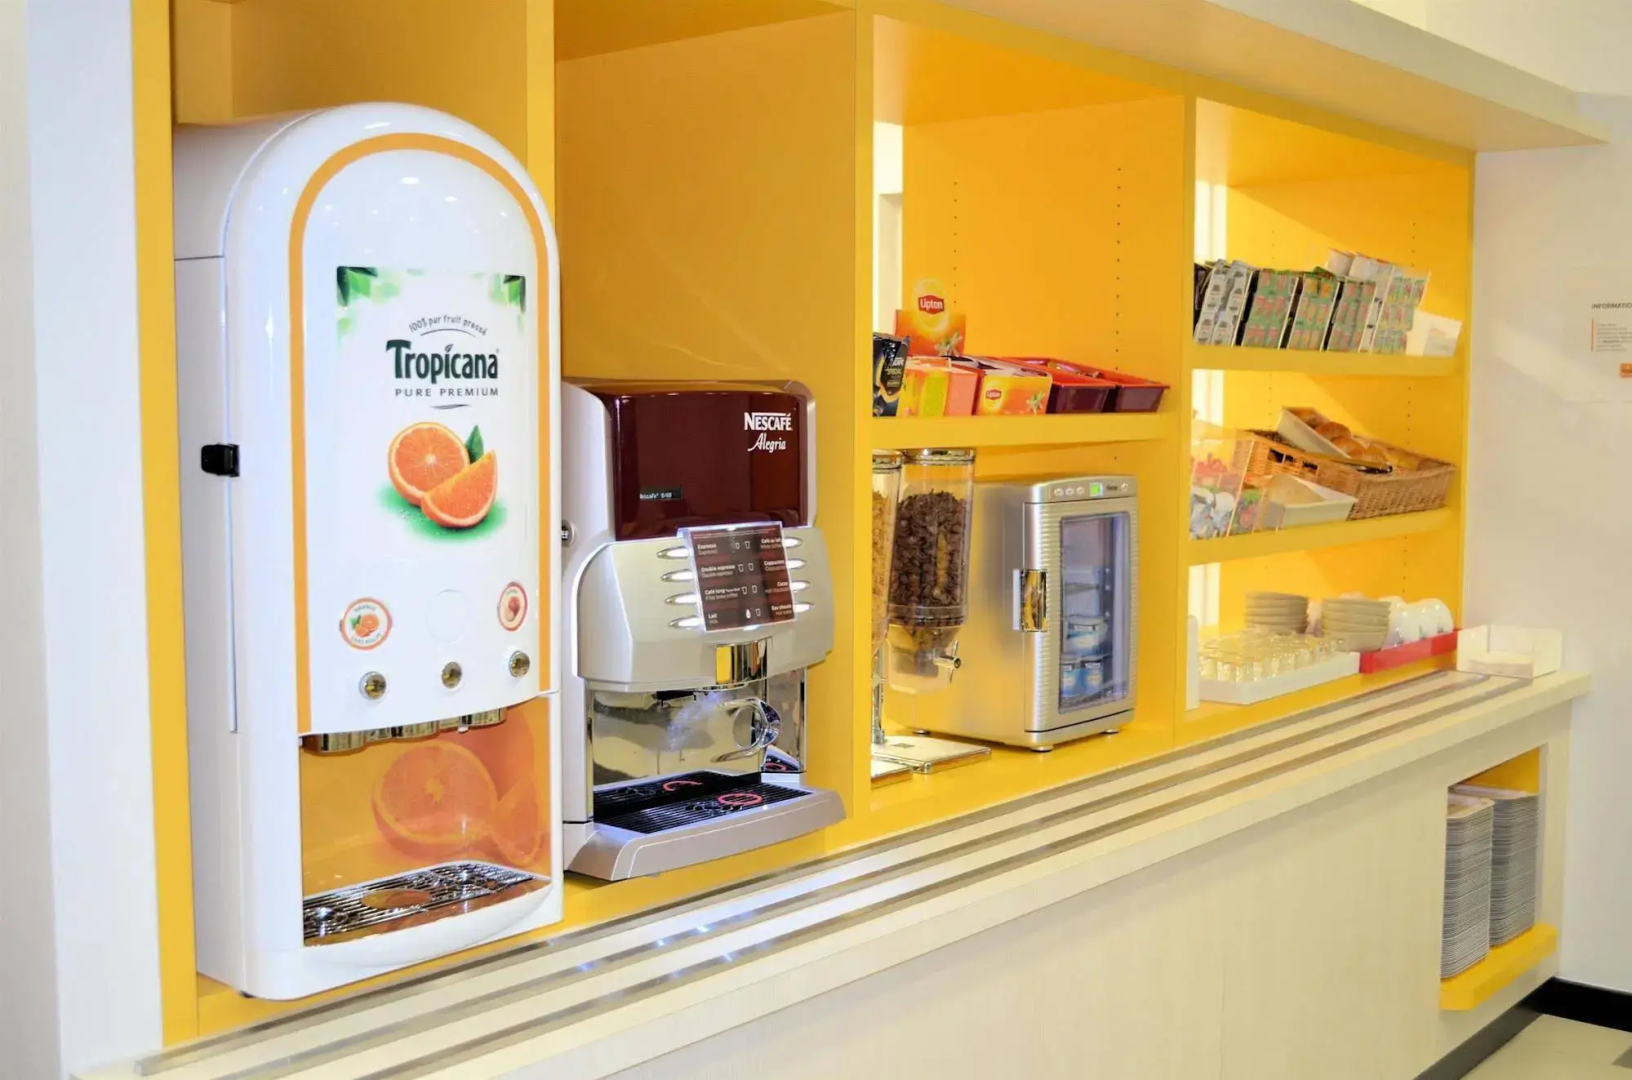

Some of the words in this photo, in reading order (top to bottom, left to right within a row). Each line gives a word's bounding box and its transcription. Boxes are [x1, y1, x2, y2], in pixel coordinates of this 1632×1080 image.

[919, 298, 943, 311] Lipton
[409, 317, 428, 332] 100%
[429, 316, 441, 327] pur
[443, 314, 461, 324] fruit
[463, 318, 487, 336] pressé
[386, 339, 498, 384] Tropicana
[395, 388, 431, 397] PURE
[440, 387, 498, 396] PREMIUM
[744, 412, 793, 431] NESCAFÉ
[747, 433, 786, 453] Alegria
